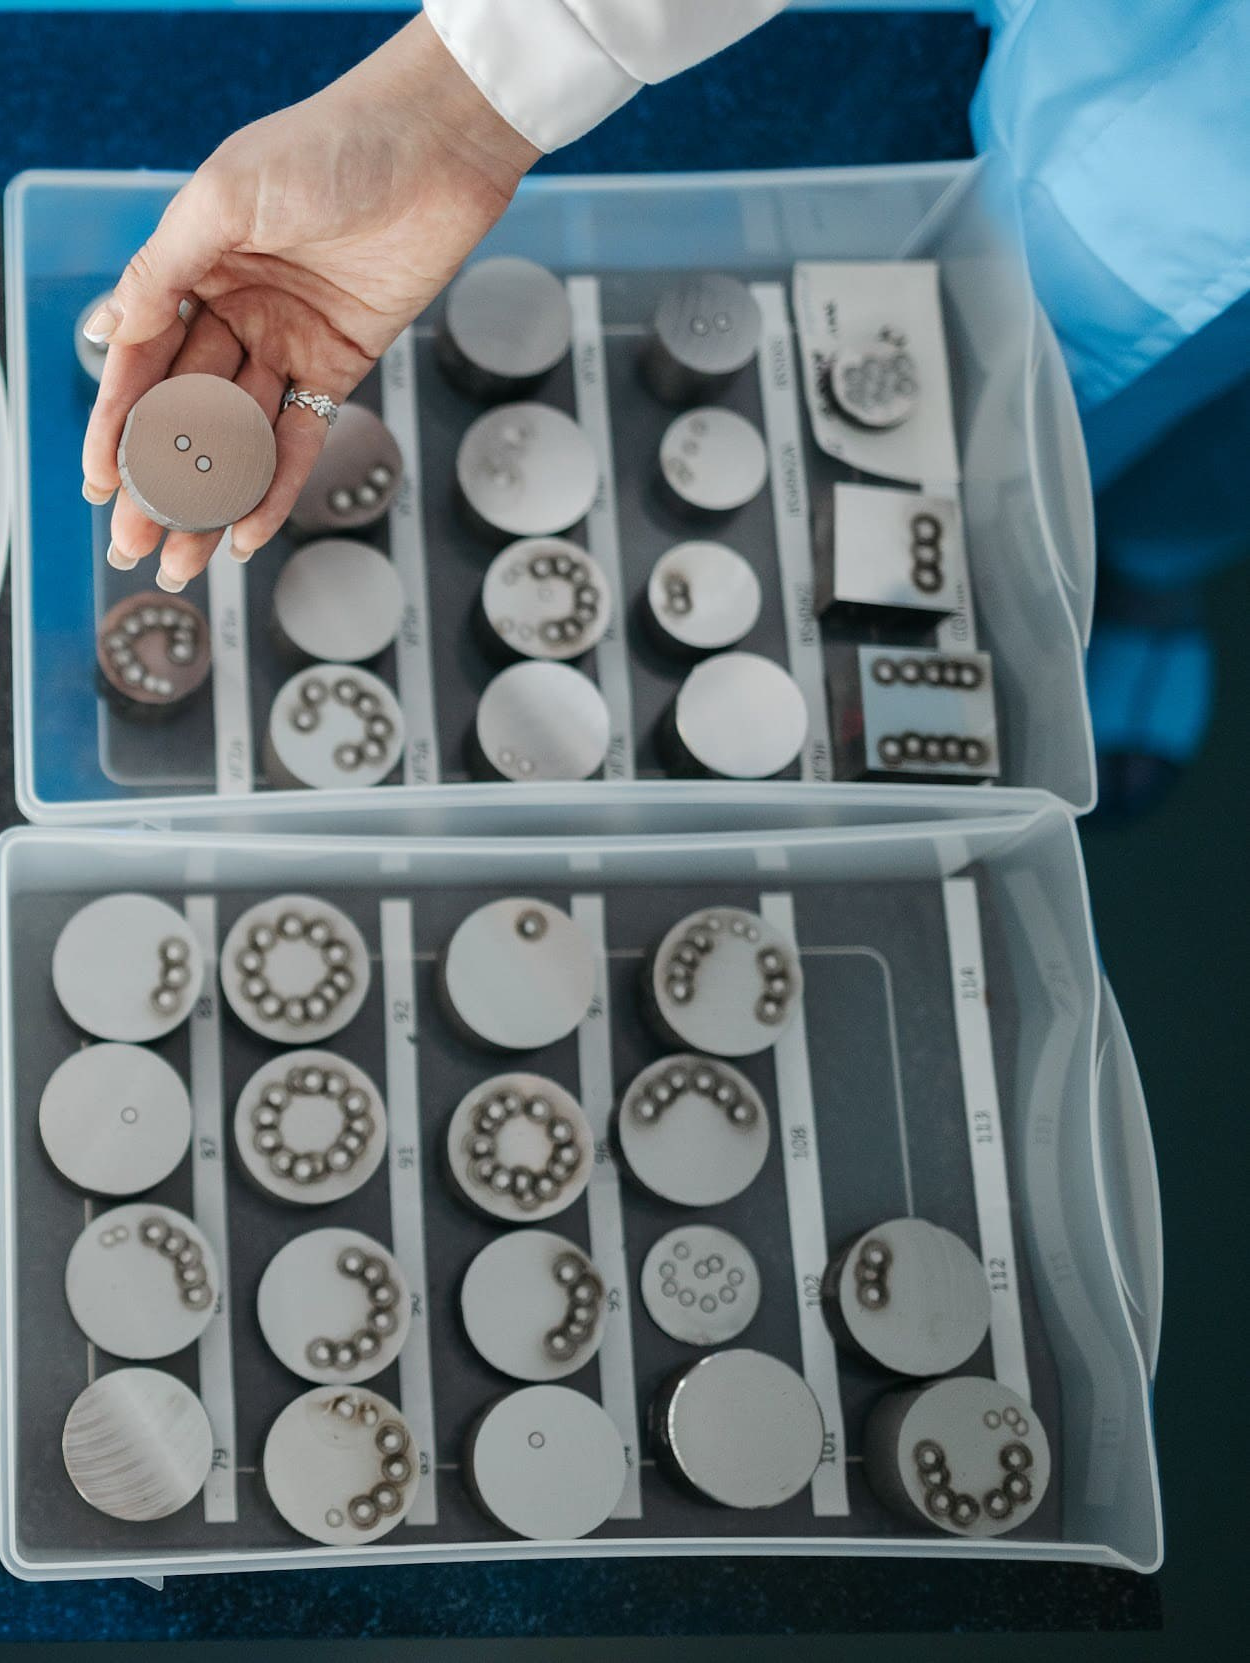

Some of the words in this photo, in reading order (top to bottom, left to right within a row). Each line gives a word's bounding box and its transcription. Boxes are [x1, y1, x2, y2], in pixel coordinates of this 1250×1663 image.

[394, 1001, 409, 1022] 92
[990, 1258, 1007, 1291] 112
[806, 1274, 821, 1308] 102
[211, 1448, 227, 1470] 79
